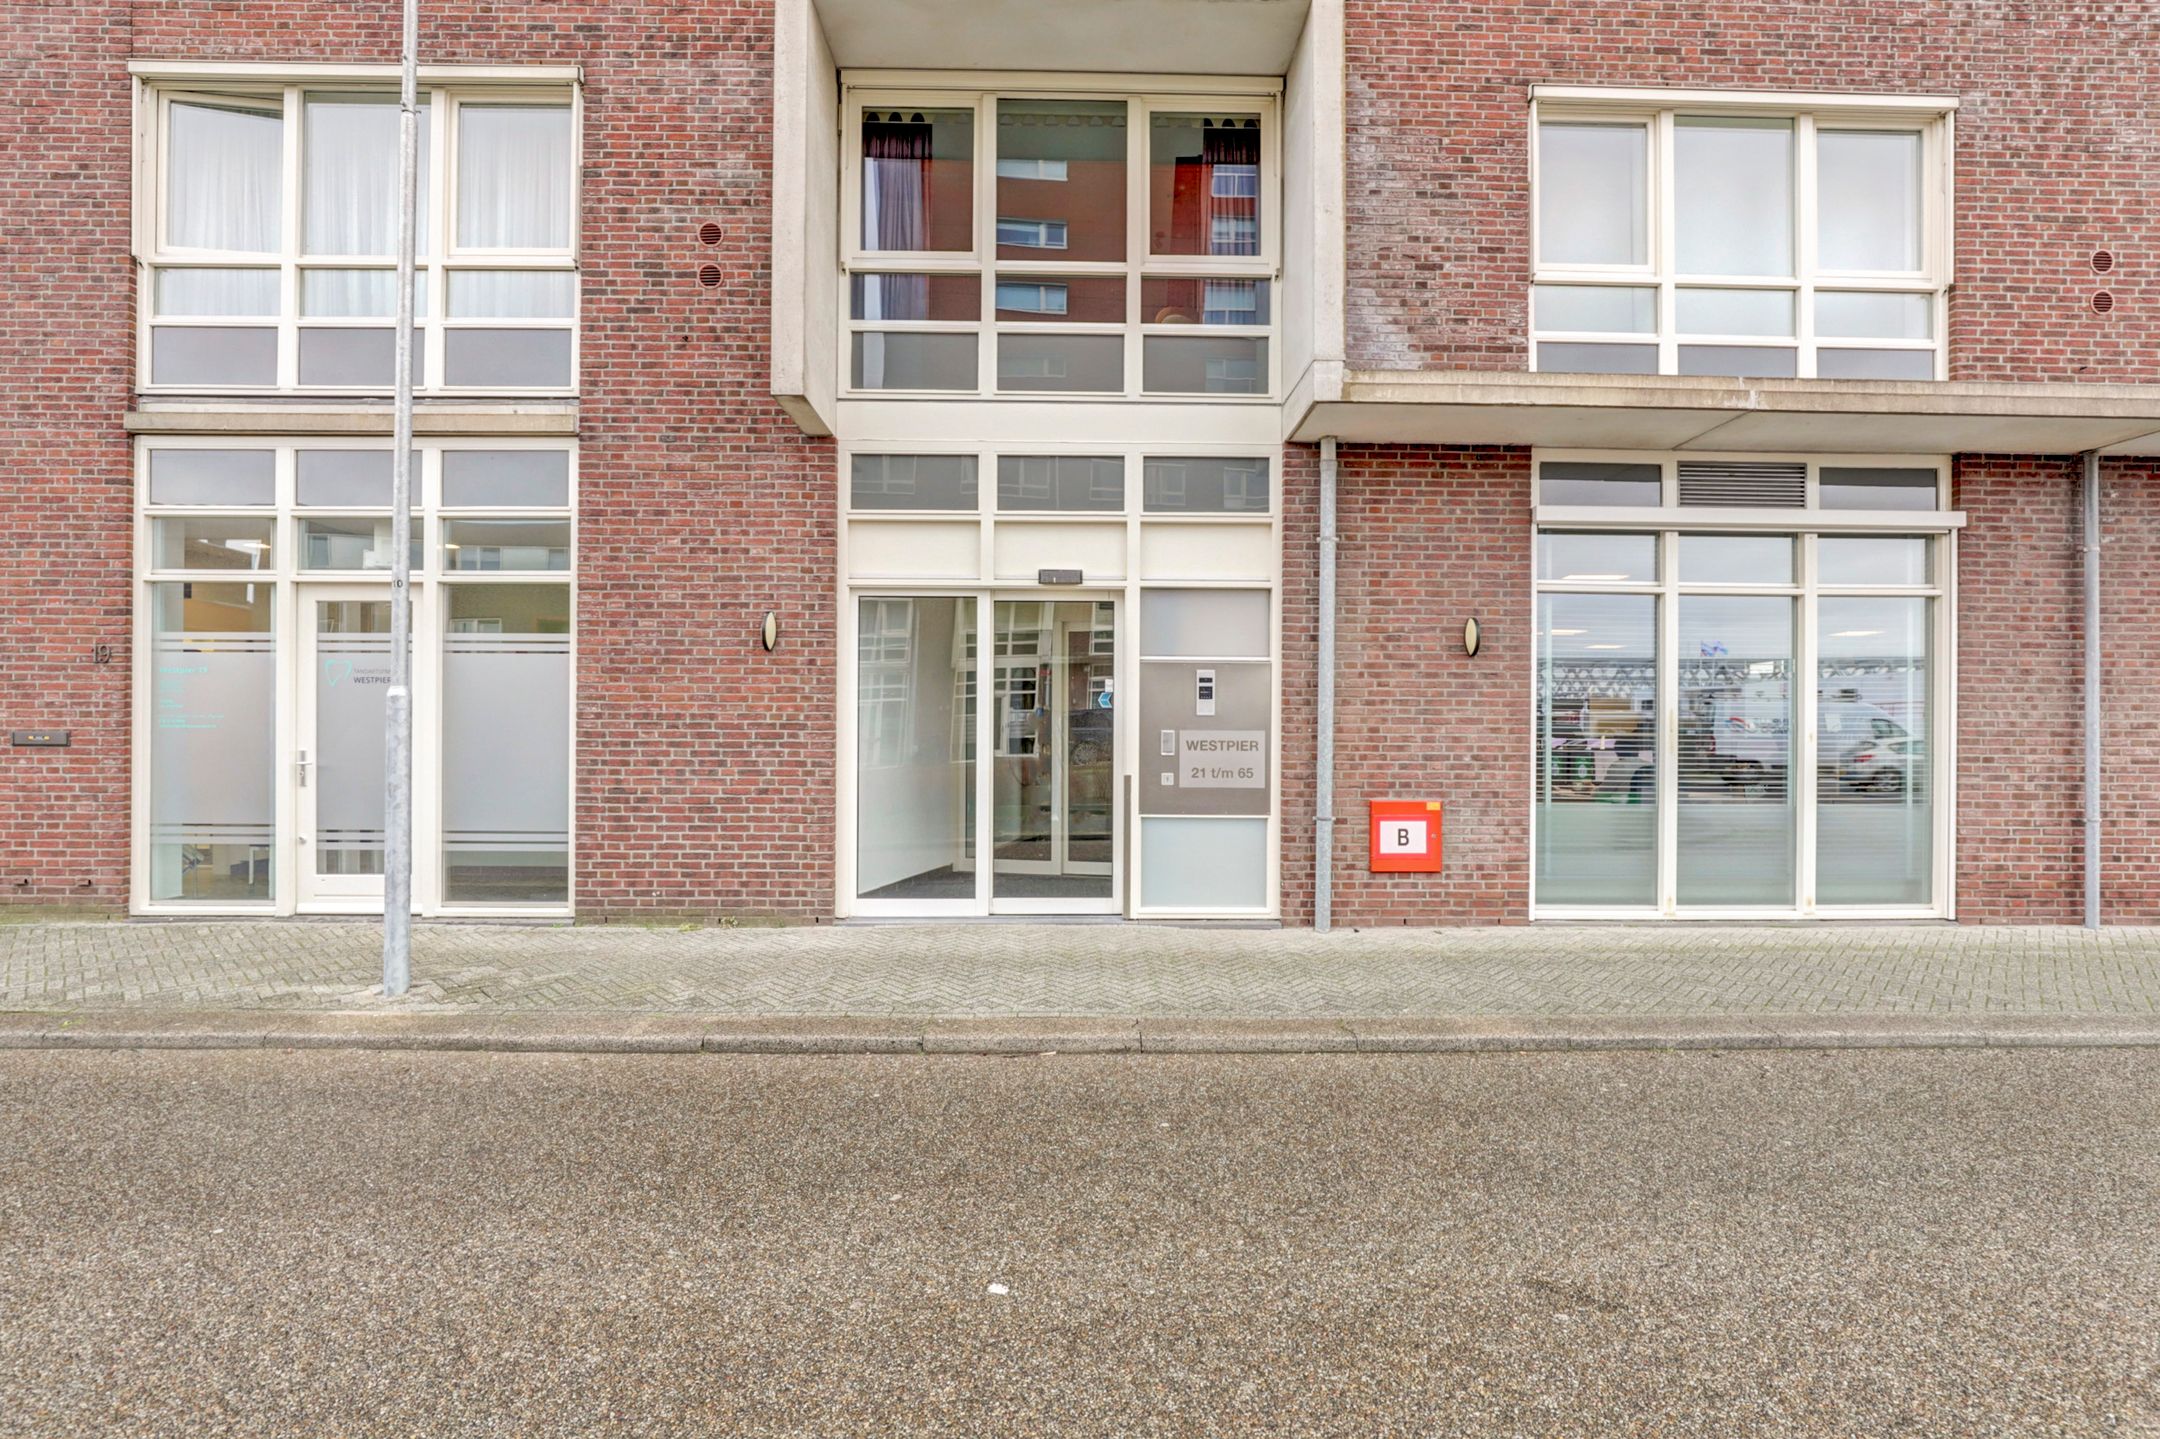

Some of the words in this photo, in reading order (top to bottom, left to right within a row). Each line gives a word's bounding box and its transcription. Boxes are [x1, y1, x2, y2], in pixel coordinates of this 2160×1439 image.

[1186, 740, 1259, 752] WESTPIER
[1191, 767, 1206, 779] 21
[1211, 767, 1234, 779] t/m
[1238, 767, 1254, 779] 65
[1397, 828, 1410, 847] B
